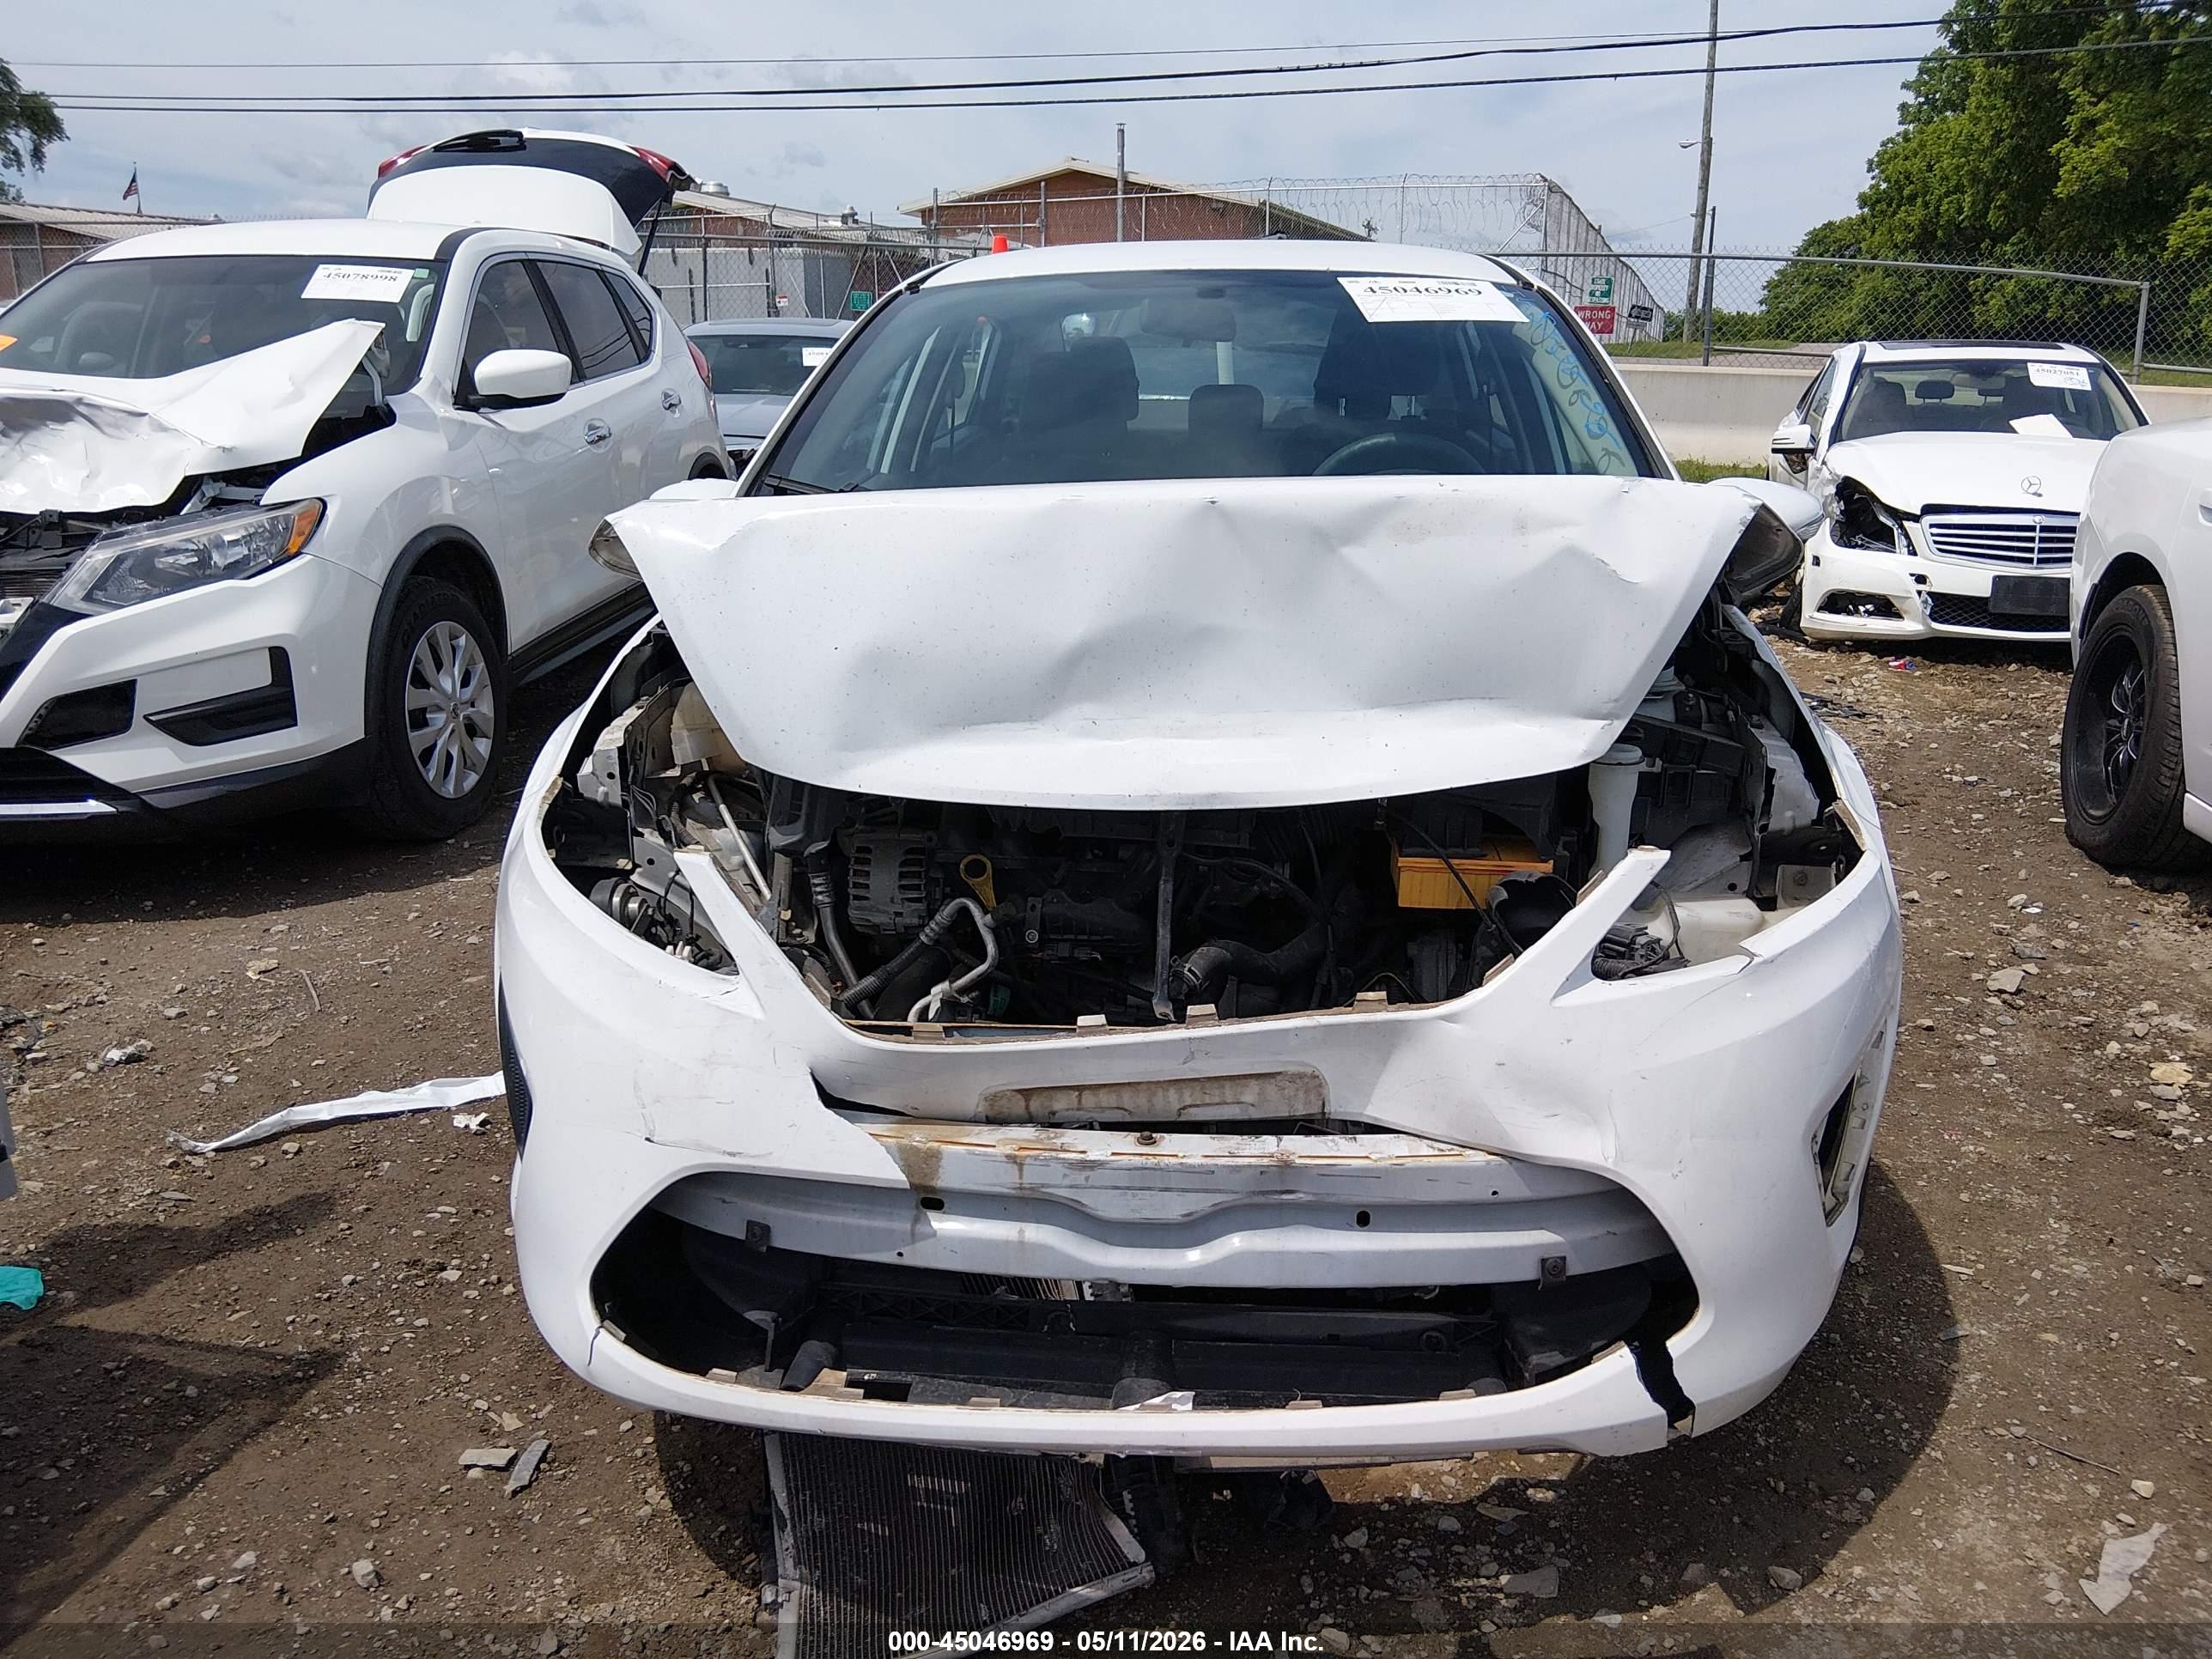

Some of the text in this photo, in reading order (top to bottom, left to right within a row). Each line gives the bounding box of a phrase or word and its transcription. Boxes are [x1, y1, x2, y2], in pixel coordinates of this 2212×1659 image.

[323, 272, 398, 282] 45078998
[1364, 286, 1482, 295] 45046969
[1577, 310, 1611, 319] WRONG
